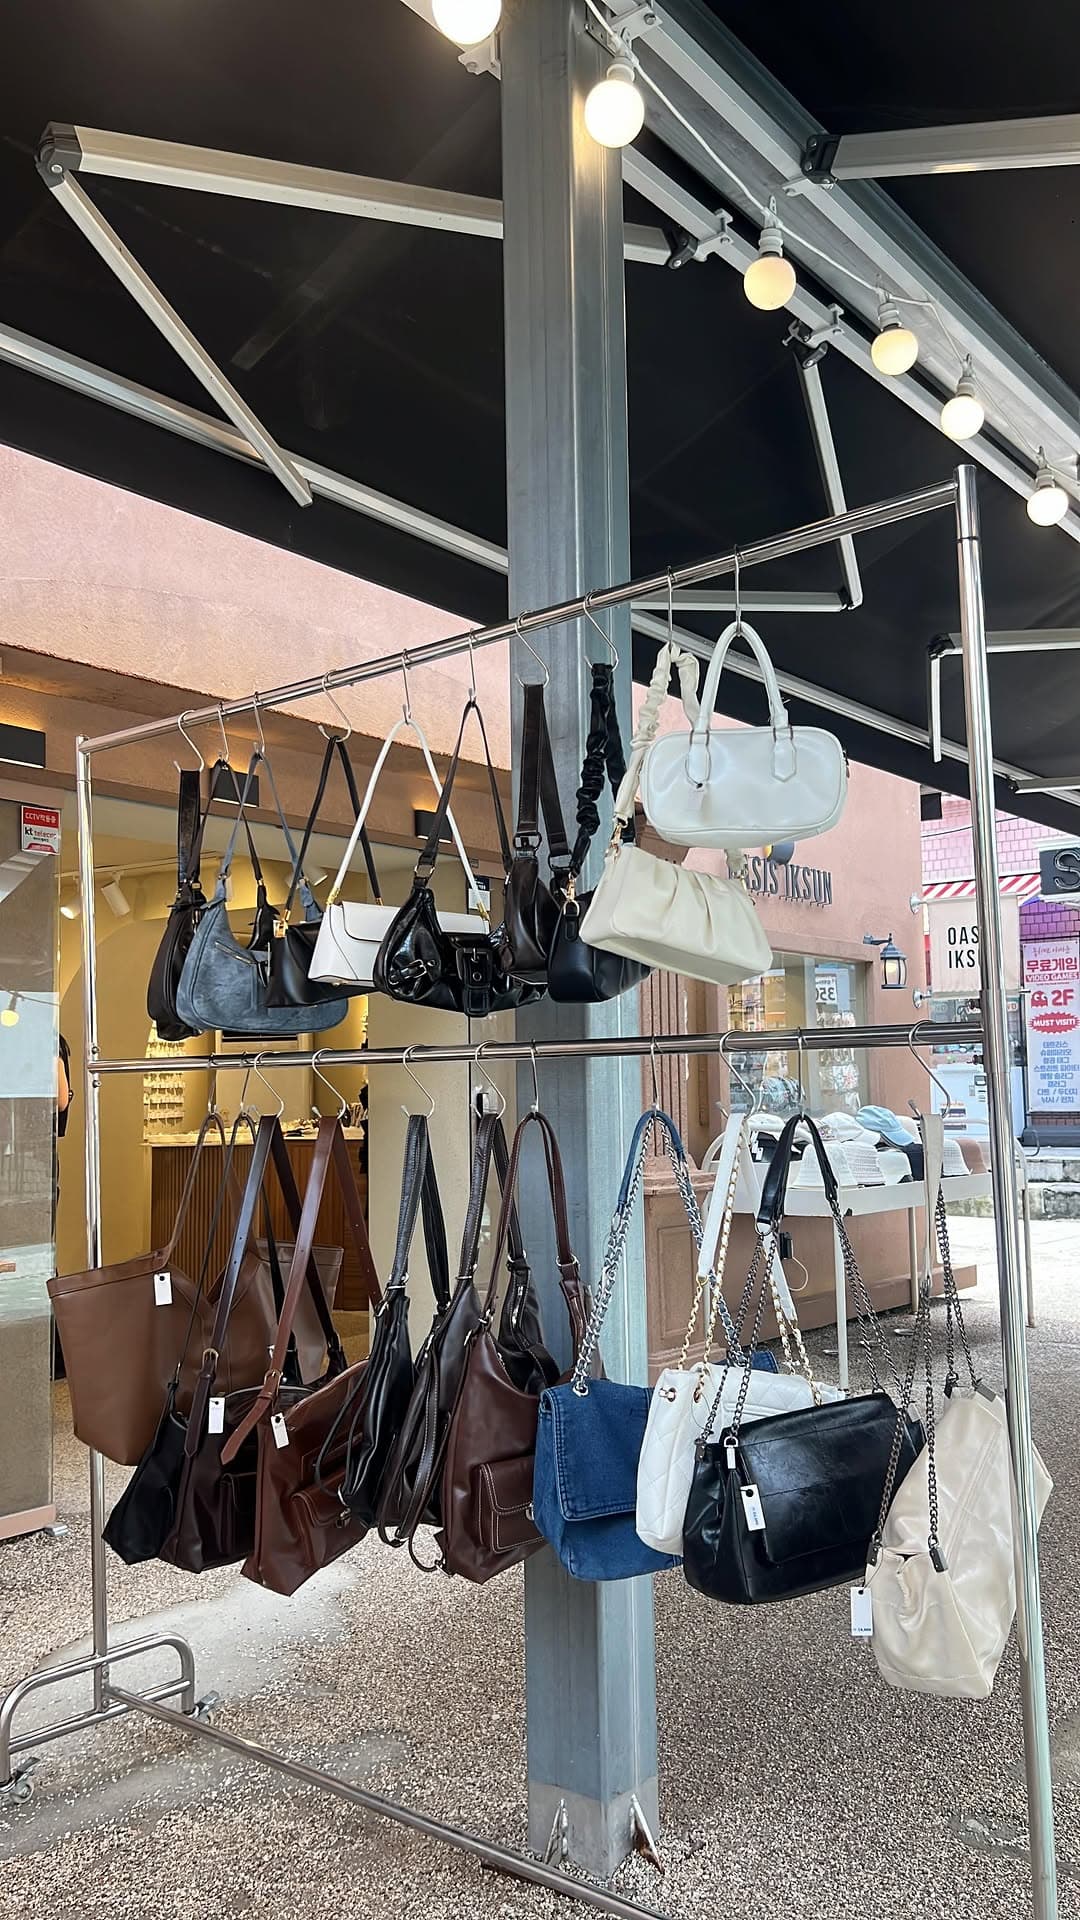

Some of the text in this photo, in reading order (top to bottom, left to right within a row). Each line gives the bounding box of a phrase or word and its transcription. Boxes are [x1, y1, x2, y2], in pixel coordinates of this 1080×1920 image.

[25, 826, 33, 836] kt
[784, 863, 832, 905] IKSUN
[948, 926, 979, 945] OAS
[948, 950, 976, 968] IKS
[1026, 957, 1077, 972] 무료게임
[1027, 972, 1078, 983] VIDEO GAMES
[1051, 989, 1075, 1006] 2F
